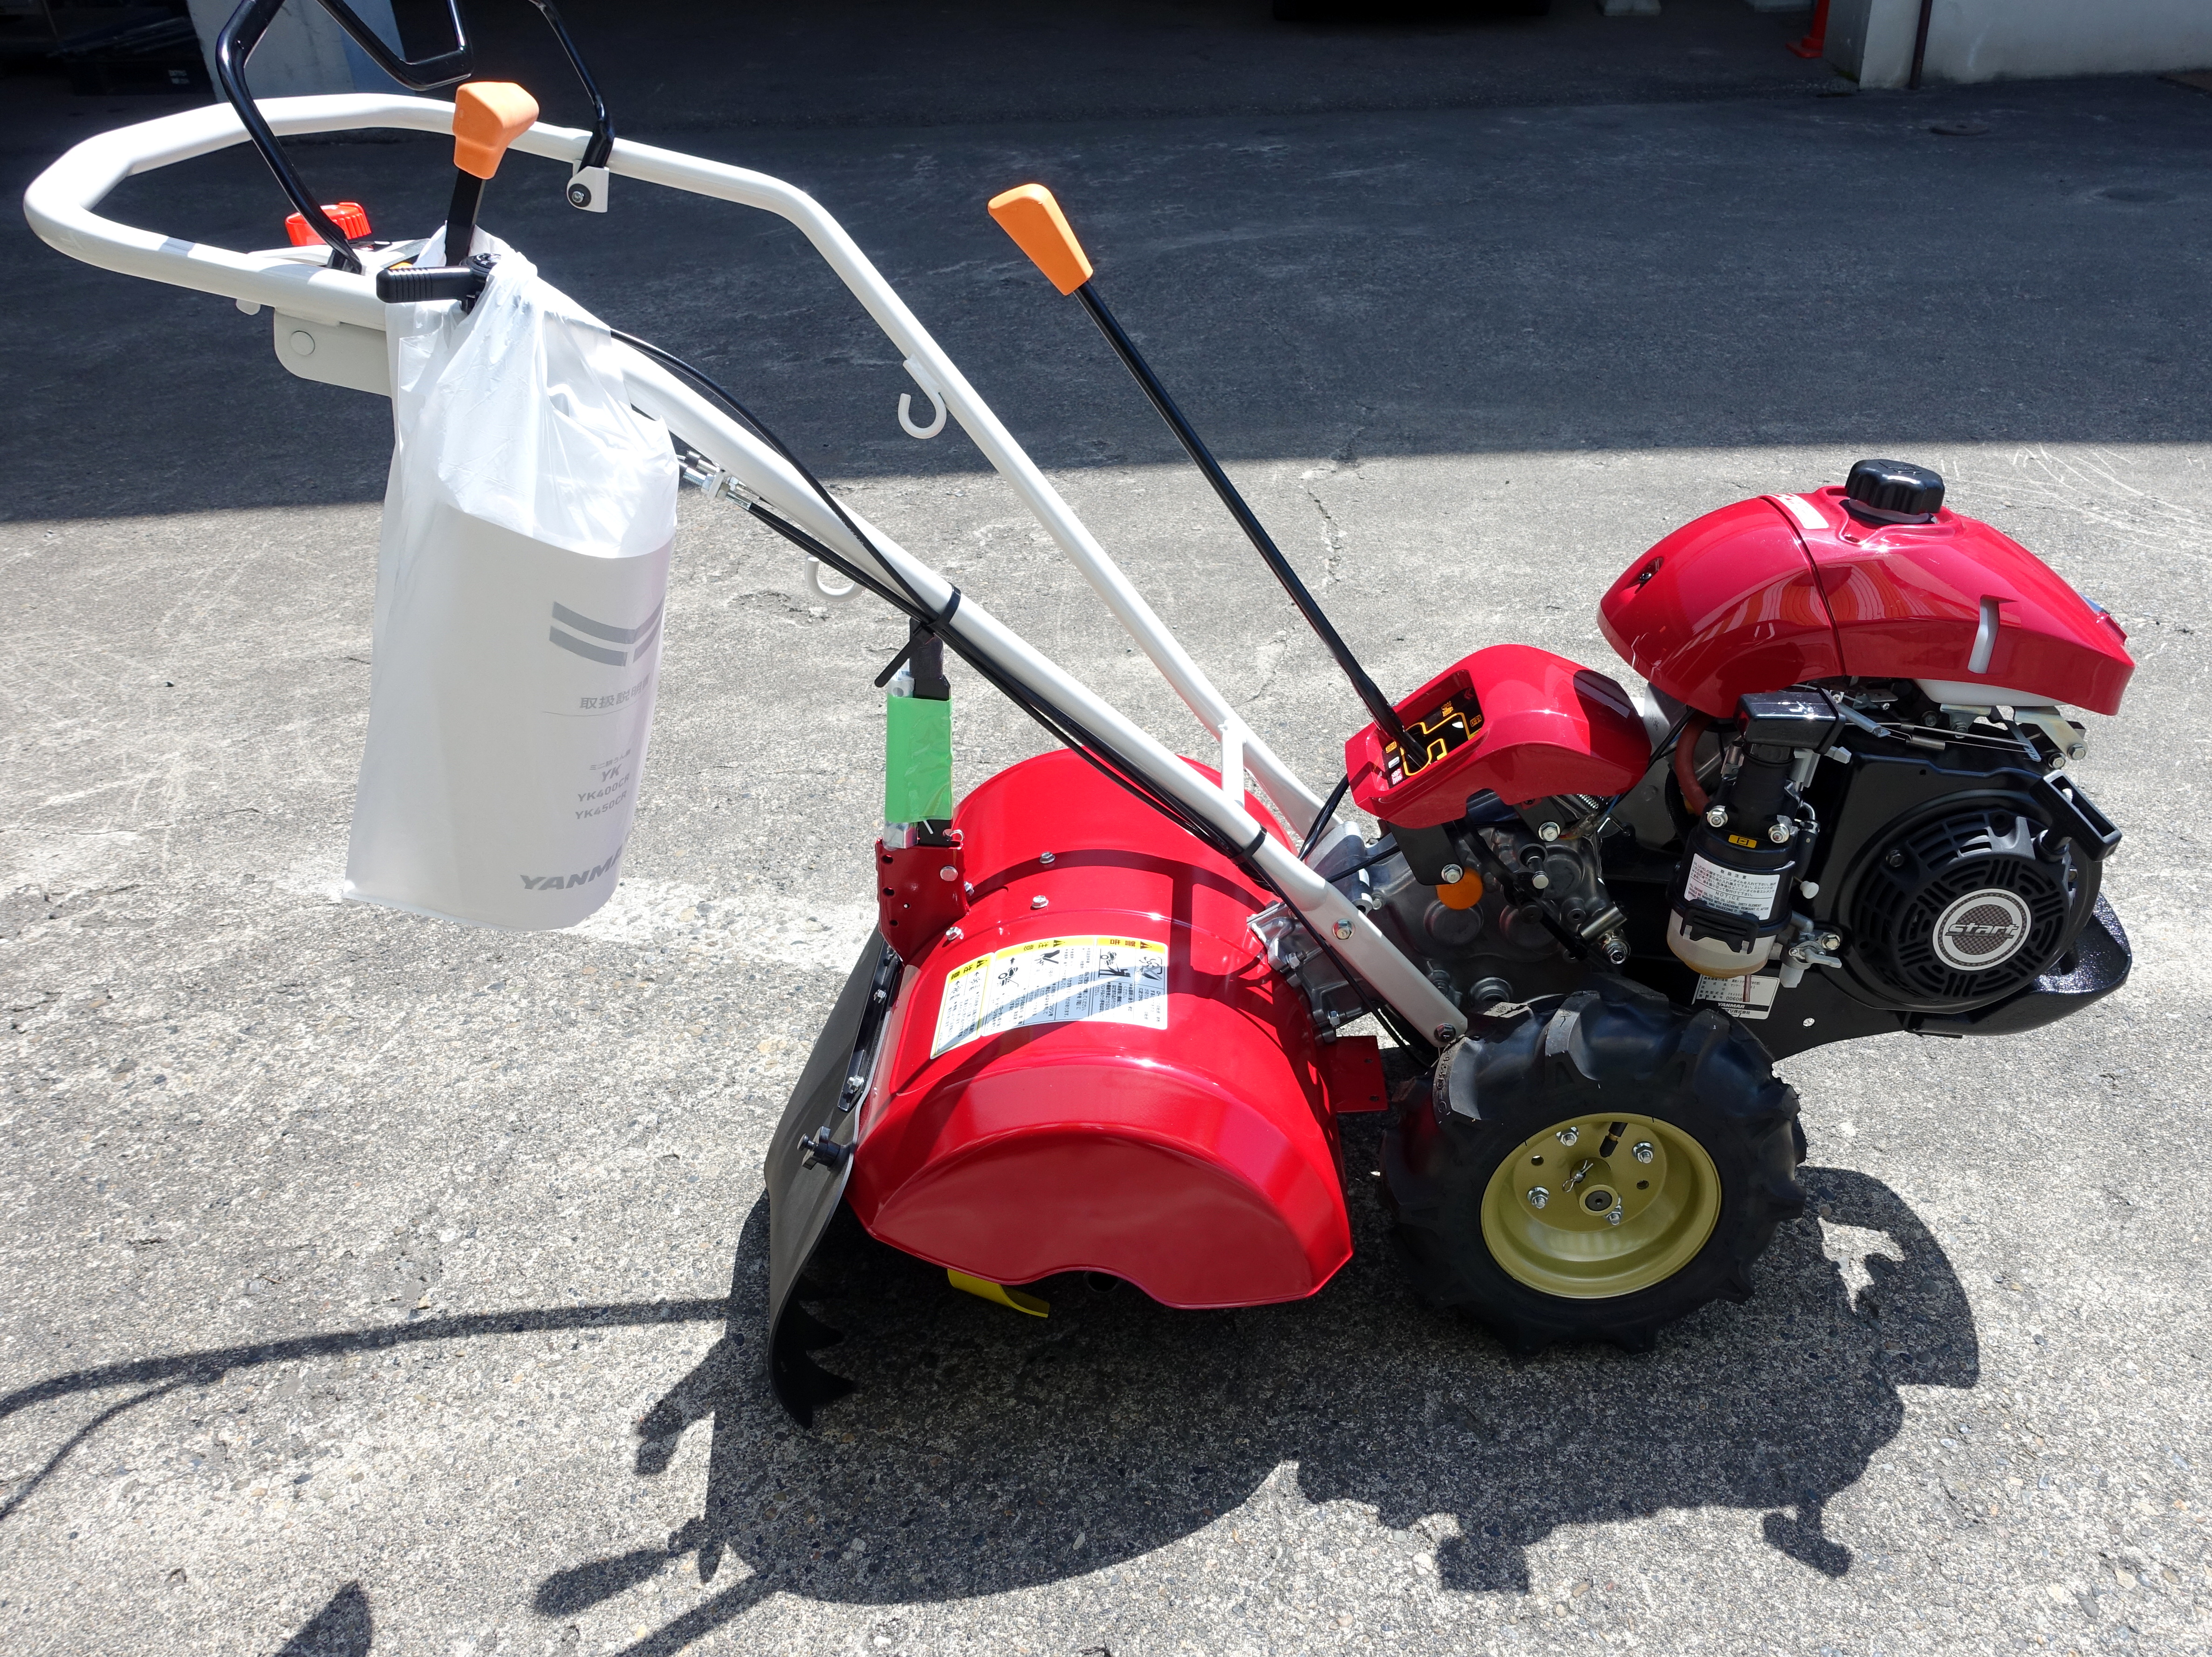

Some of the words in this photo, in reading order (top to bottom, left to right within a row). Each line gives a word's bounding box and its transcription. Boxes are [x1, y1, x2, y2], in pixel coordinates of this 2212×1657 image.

[602, 764, 622, 782] YK
[577, 773, 630, 802] YK400CR
[575, 790, 627, 819] YK450CR
[1715, 892, 1740, 901] NOTICE
[1948, 922, 2020, 936] start
[1023, 941, 1049, 951] 注意
